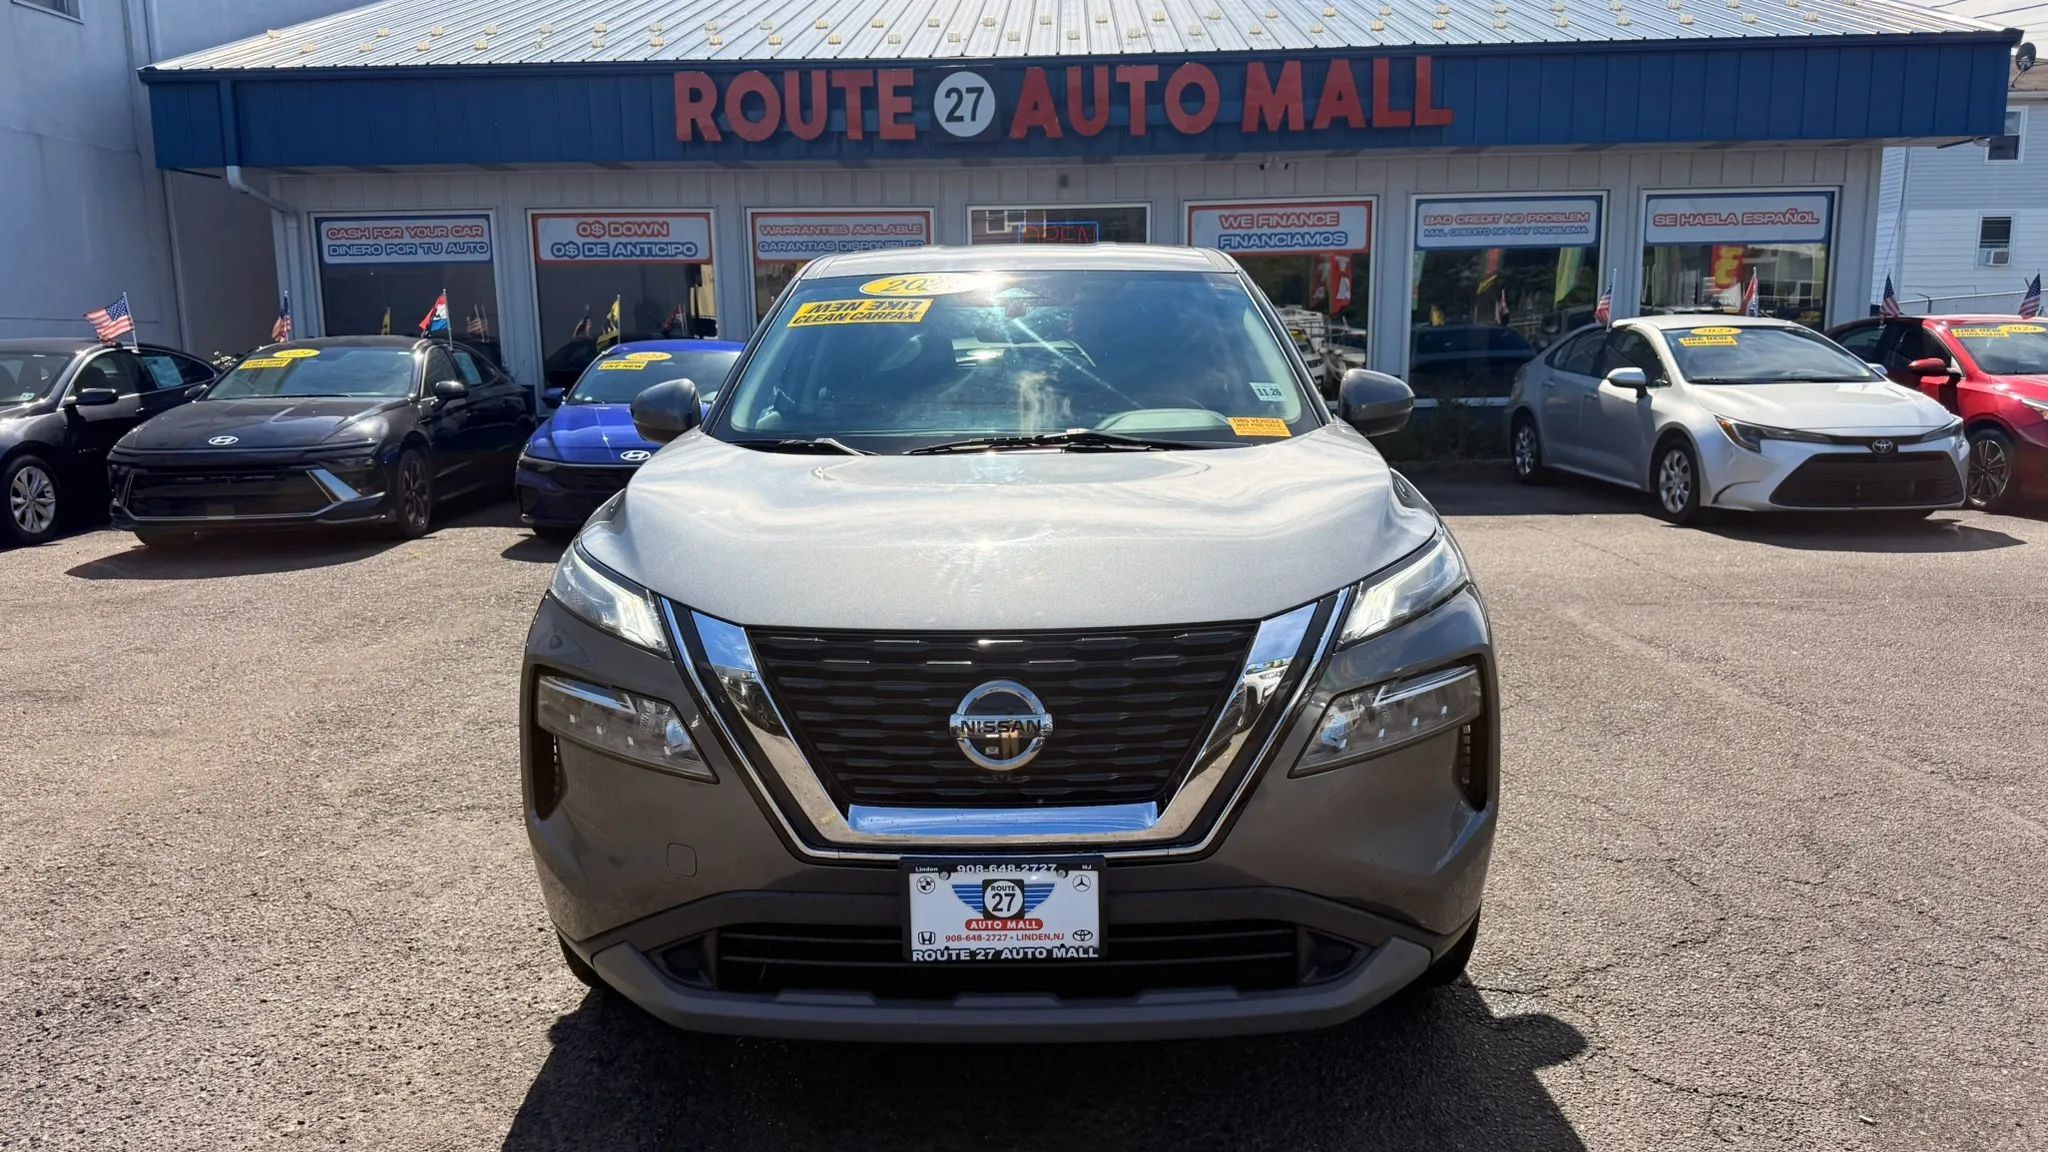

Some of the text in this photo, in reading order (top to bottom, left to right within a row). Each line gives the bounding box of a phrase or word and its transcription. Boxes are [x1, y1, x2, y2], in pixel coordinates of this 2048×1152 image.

[674, 55, 1454, 142] ROUTE 27 AUTO MALL
[1219, 212, 1340, 229] WE FINANCE
[1424, 212, 1590, 226] BAD CREDIT NO PROBLEM
[1654, 208, 1819, 227] SE HABLA ESPAÑOL
[327, 224, 484, 240] CASH FOR YOUR CAR
[608, 221, 669, 238] DOWN
[760, 223, 923, 236] WARRANTIES AVAILABLE
[1424, 225, 1589, 237] MAL CREDITO NO HAY PROBLEMA
[758, 240, 837, 253] GARANTIAS
[1218, 231, 1348, 249] FINANCIAMOS
[328, 242, 488, 256] DINERO POR TU AUTO
[582, 242, 611, 258] DE
[612, 241, 698, 257] ANTICIPO
[808, 302, 862, 313] NEW
[793, 311, 917, 324] CLEAN CARFAX
[961, 720, 1041, 733] NISSAN
[957, 864, 1057, 873] 908-648-2727
[991, 893, 1016, 912] 27
[970, 920, 1038, 929] AUTO MALL
[945, 934, 1008, 943] 908-648-2727
[912, 946, 1099, 961] ROUTE 27 AUTO MALL
